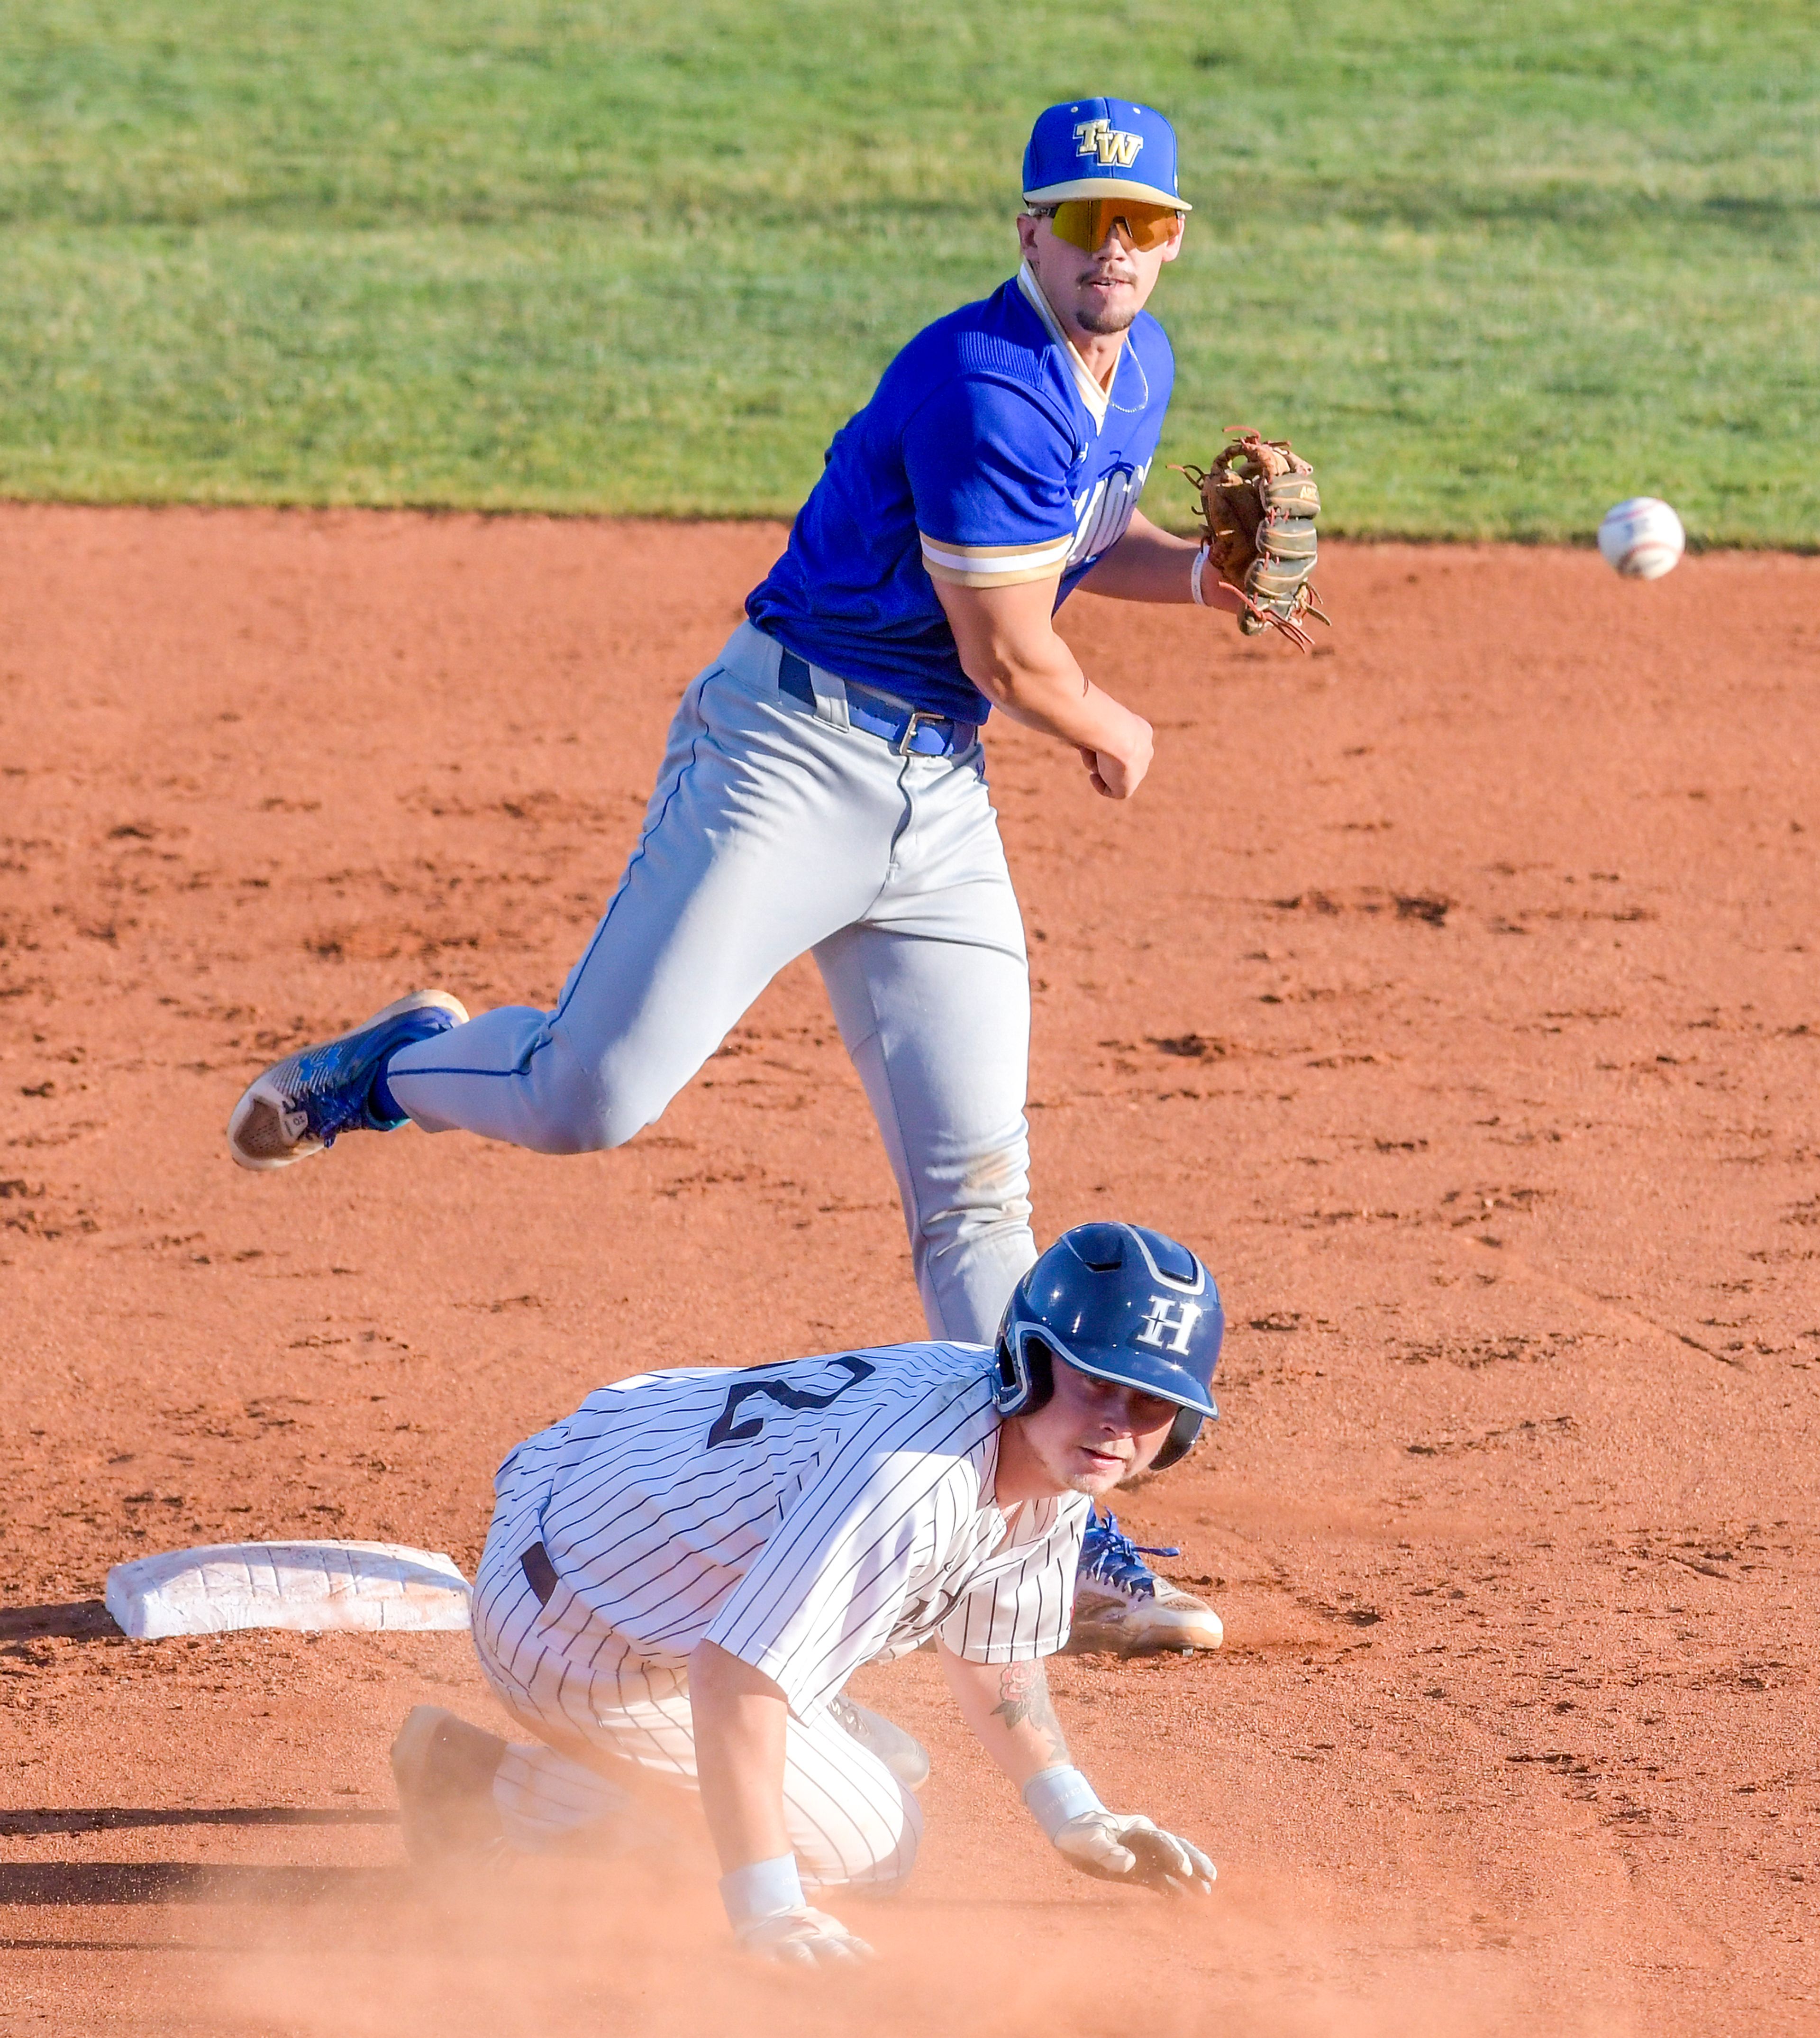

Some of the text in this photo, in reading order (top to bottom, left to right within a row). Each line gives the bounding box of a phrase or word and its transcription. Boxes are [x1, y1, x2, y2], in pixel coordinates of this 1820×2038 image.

[1073, 119, 1143, 168] TW
[1137, 1295, 1201, 1356] H
[707, 1355, 876, 1450] 2
